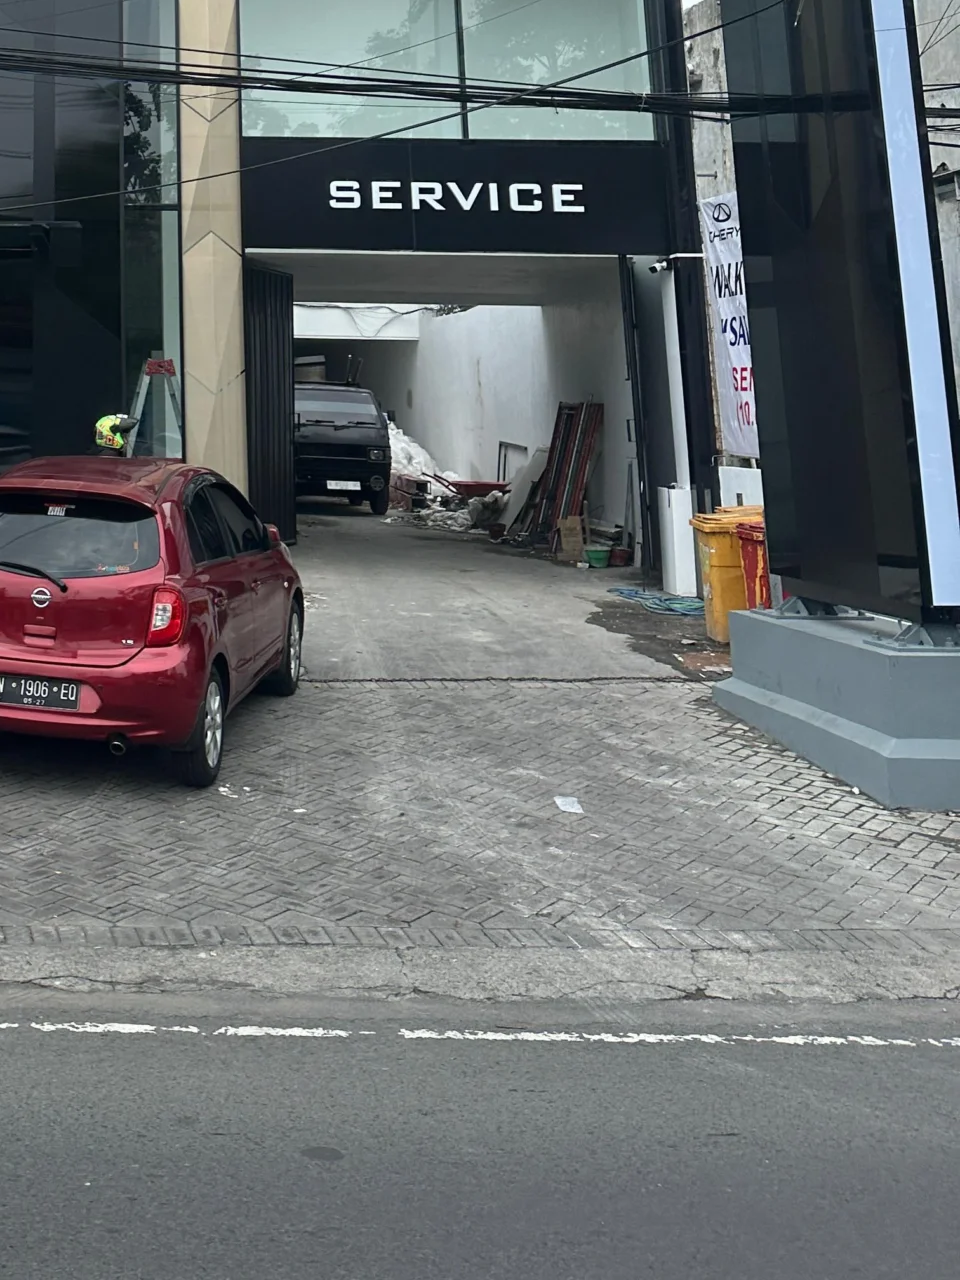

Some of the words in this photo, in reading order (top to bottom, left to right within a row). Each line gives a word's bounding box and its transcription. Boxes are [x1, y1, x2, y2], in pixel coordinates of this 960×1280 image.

[329, 180, 585, 213] SERVICE
[709, 226, 741, 243] CHERY
[20, 679, 49, 698] 1906
[23, 697, 45, 705] 05-27
